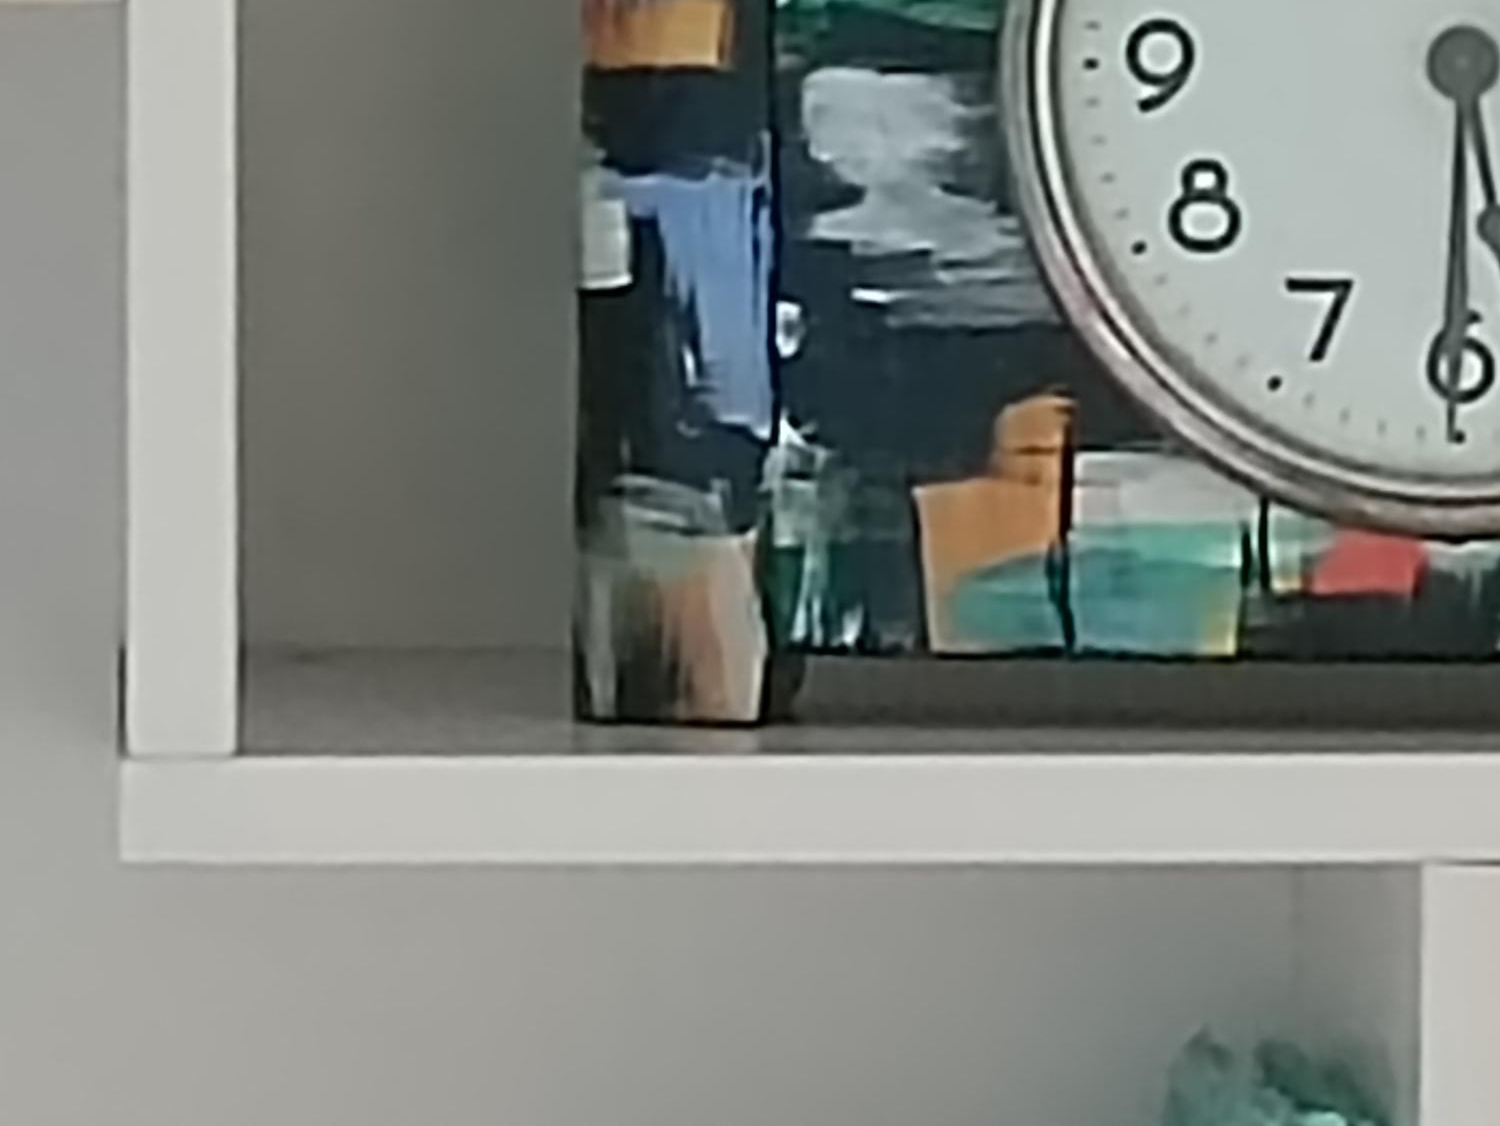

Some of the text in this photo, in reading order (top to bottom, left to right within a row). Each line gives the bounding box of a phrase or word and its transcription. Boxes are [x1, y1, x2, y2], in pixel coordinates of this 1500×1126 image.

[1125, 18, 1196, 113] 9
[1167, 158, 1242, 254] 8
[1284, 277, 1355, 363] 7
[1425, 308, 1497, 404] 6
